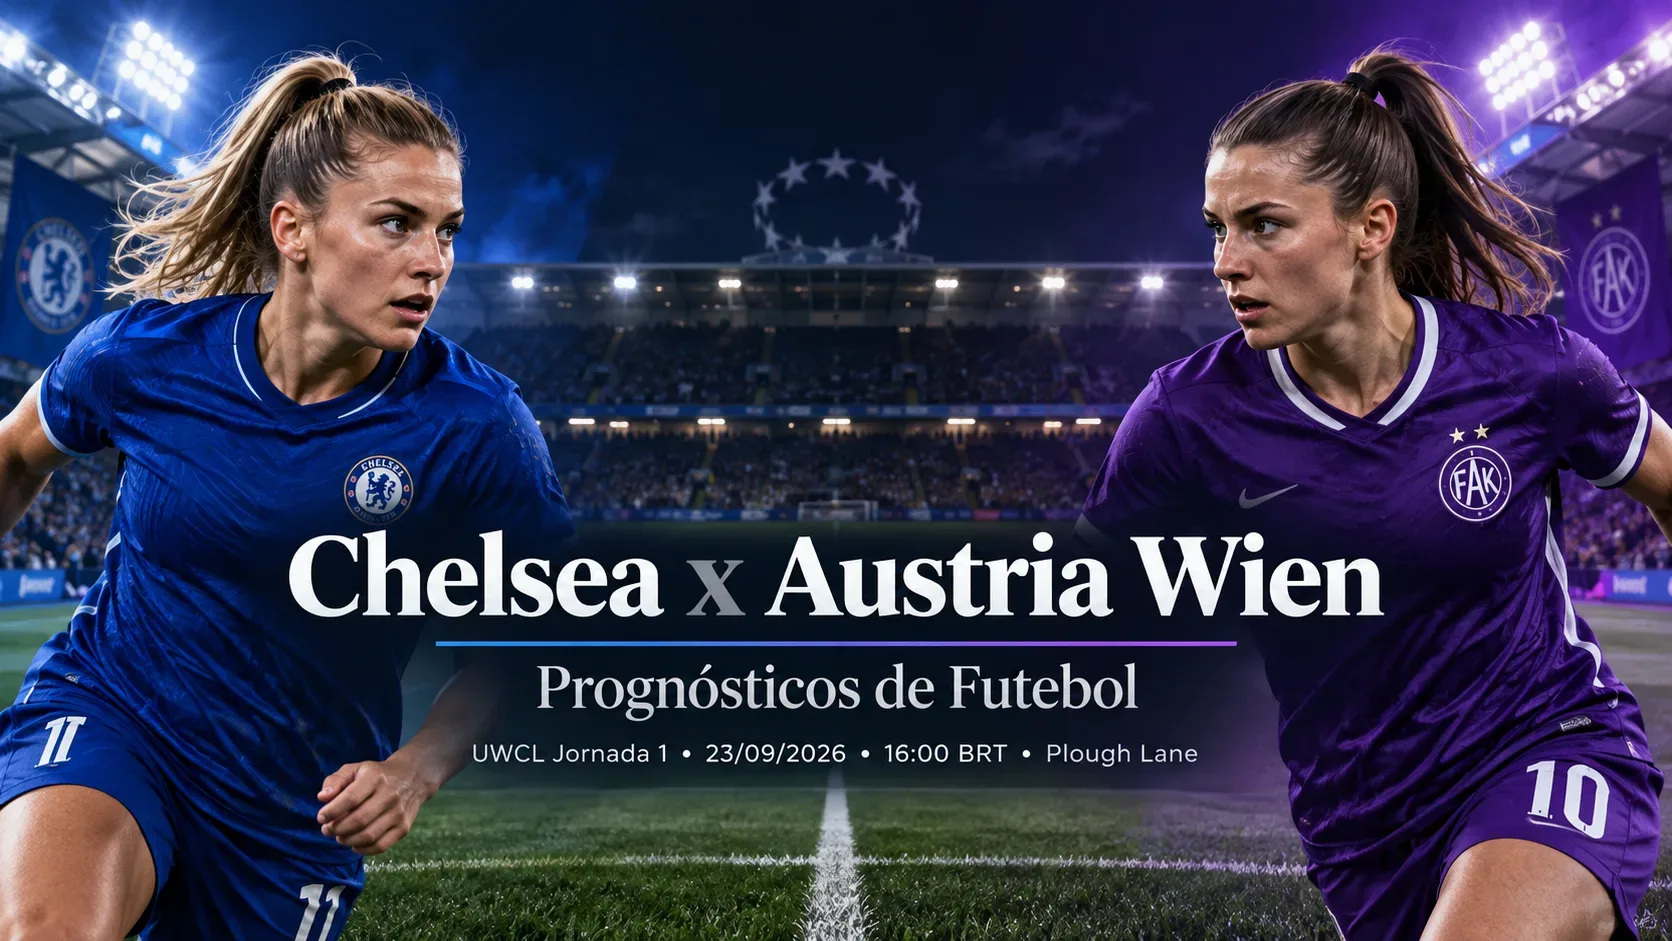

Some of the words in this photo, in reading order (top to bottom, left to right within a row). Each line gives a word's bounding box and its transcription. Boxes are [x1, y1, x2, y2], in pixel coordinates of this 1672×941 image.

[1591, 246, 1634, 312] FAK
[1453, 459, 1499, 506] FAK
[1526, 760, 1610, 839] 10
